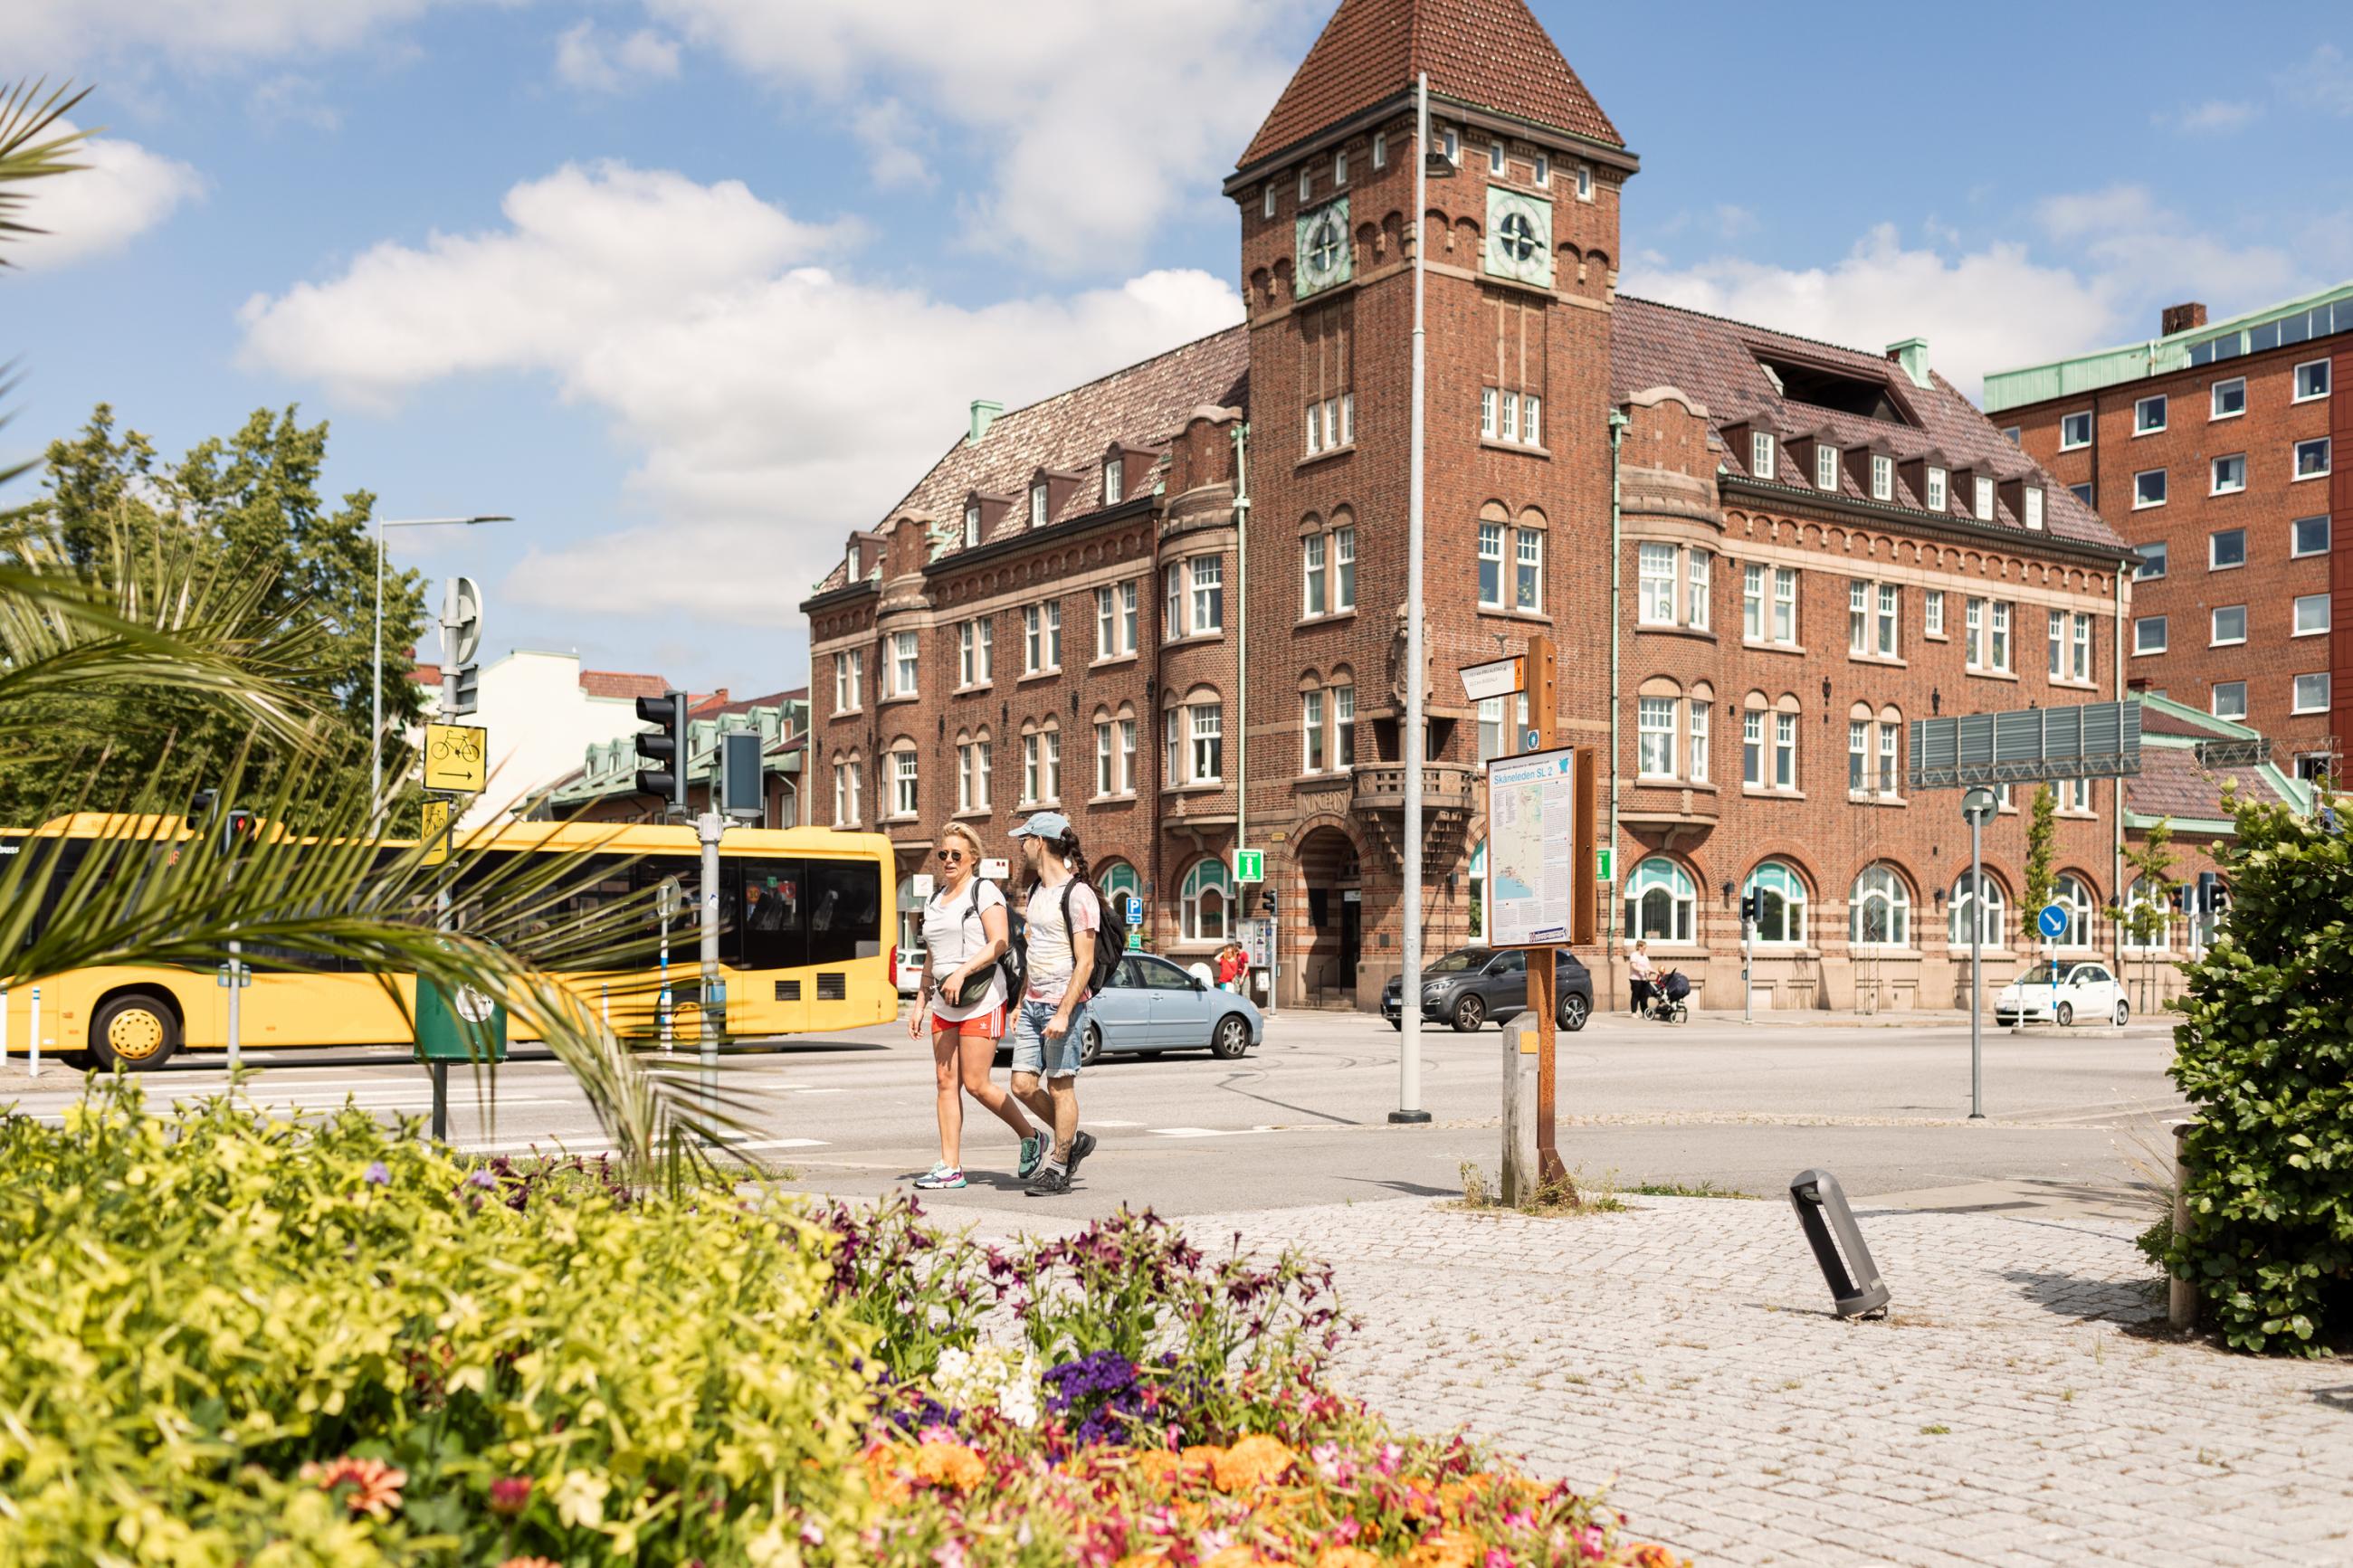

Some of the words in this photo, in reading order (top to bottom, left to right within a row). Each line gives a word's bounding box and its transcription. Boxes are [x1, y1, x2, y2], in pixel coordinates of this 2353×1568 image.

[1494, 771, 1535, 784] Skåneleden
[1536, 767, 1546, 777] SL
[1548, 766, 1553, 775] 2
[1130, 899, 1139, 914] P
